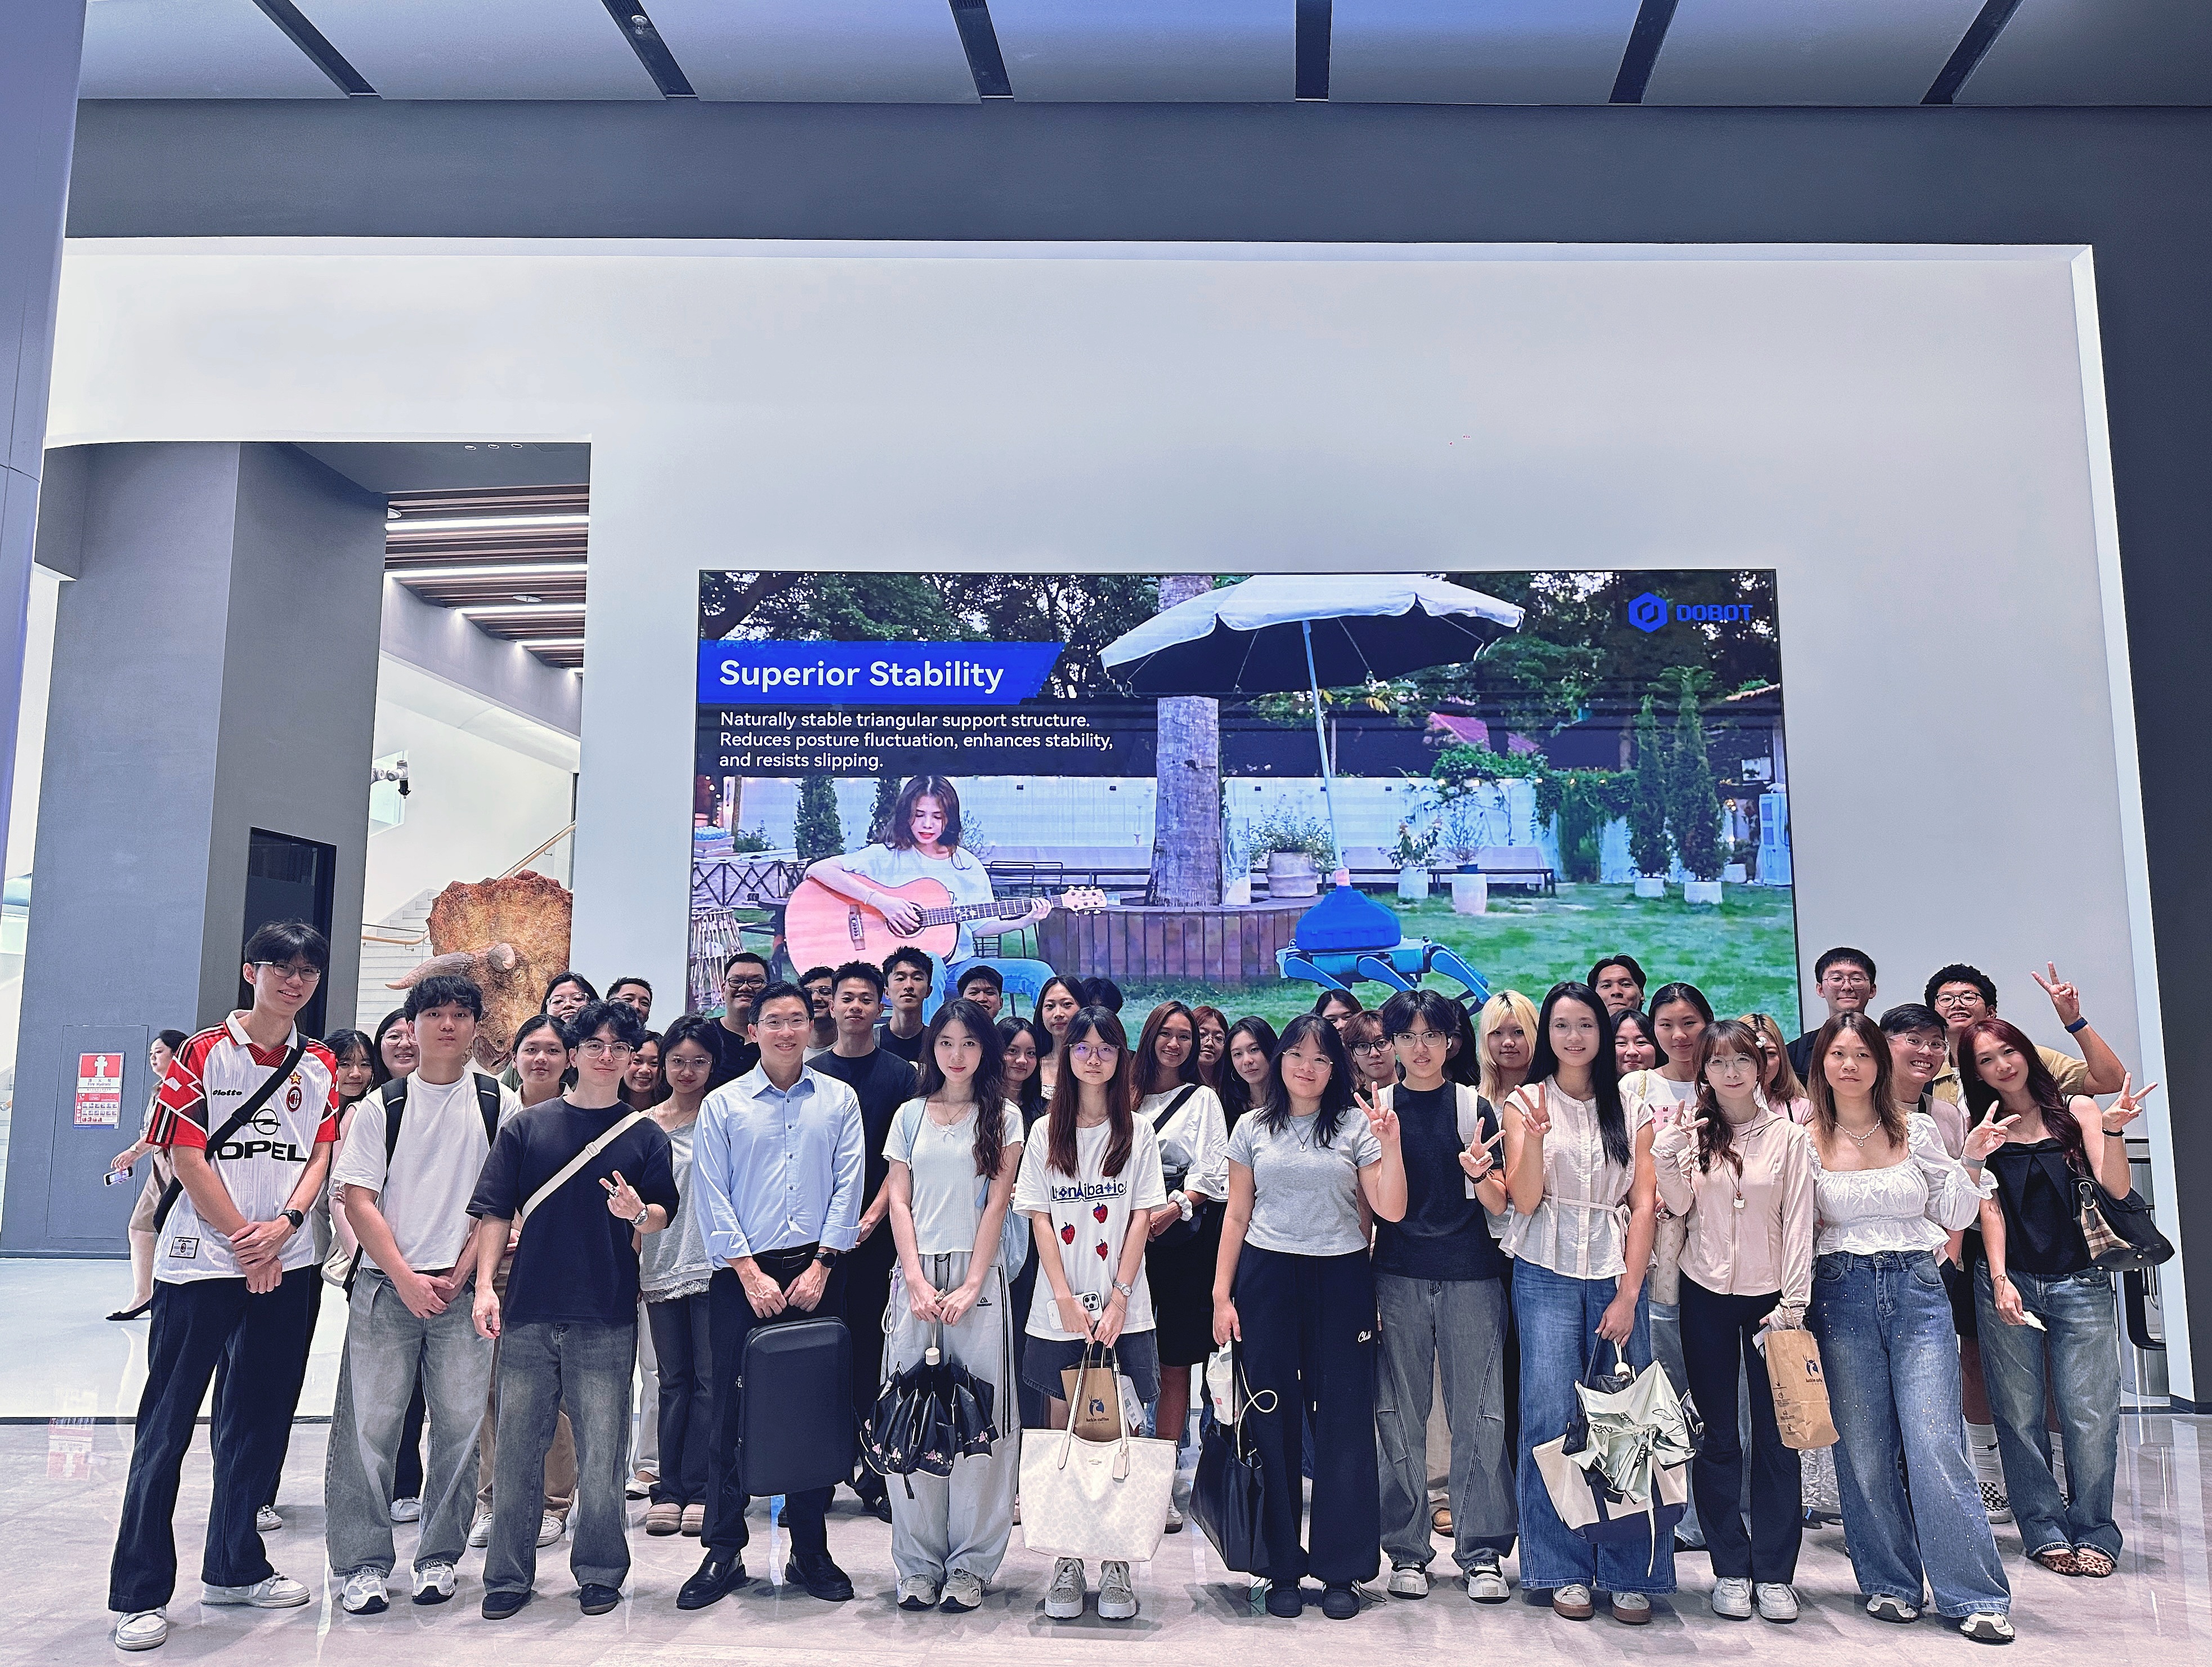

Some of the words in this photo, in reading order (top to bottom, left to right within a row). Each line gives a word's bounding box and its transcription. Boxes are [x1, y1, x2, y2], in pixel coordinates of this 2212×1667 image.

[1676, 604, 1754, 621] DOBOT
[719, 659, 860, 693] Superior
[869, 660, 1004, 694] Stability
[720, 712, 796, 730] Naturally
[801, 712, 852, 727] stable
[856, 712, 938, 731] triangular
[942, 713, 1007, 731] support
[1011, 713, 1090, 727] structure.
[720, 732, 791, 747] Reduces
[796, 734, 859, 750] posture
[863, 732, 959, 750] fluctuation,
[963, 732, 1041, 748] enhances
[1045, 732, 1113, 751] stability,
[719, 753, 751, 767] and
[756, 753, 809, 767] resists
[814, 752, 883, 771] slipping.
[217, 1140, 307, 1162] OPEL
